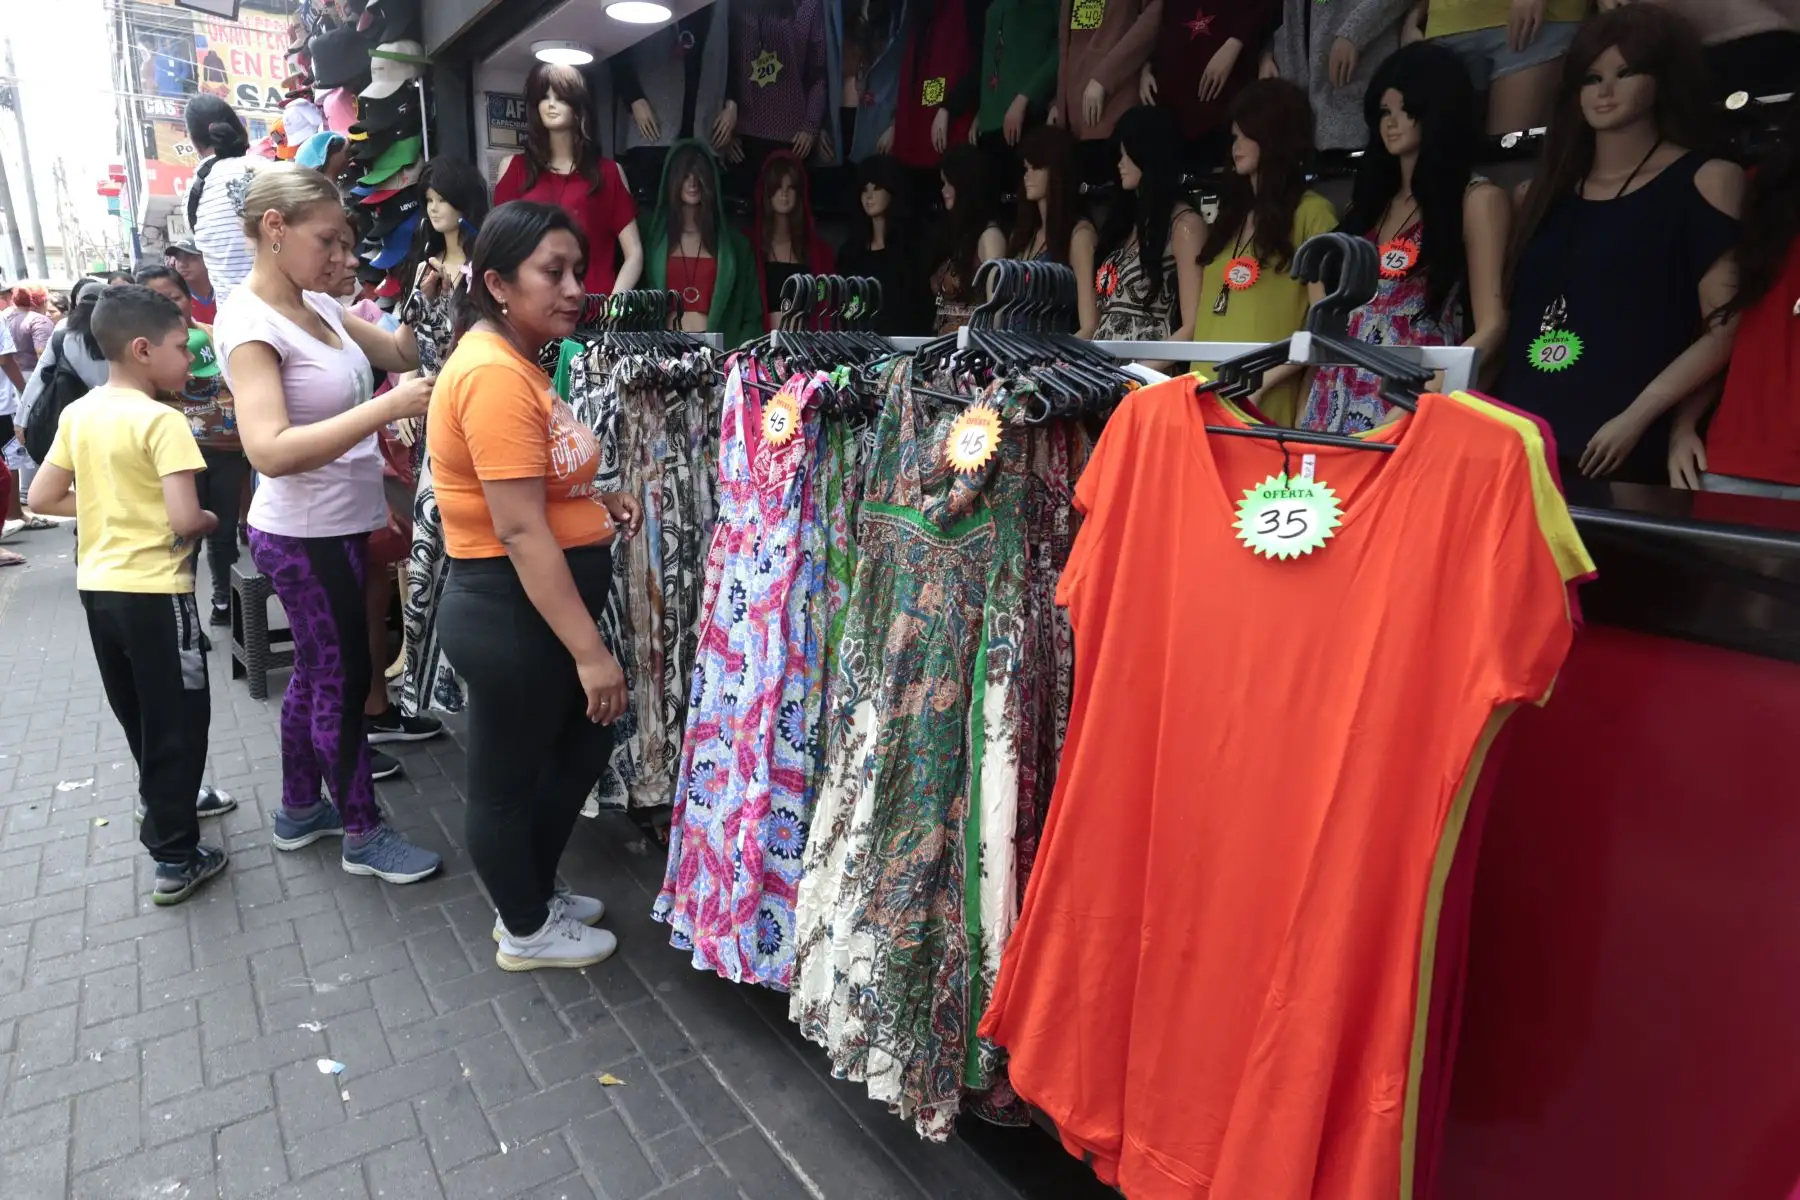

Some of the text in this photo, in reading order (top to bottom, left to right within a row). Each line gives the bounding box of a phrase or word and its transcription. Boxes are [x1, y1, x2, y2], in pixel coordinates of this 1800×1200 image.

[1085, 10, 1099, 22] 40
[230, 49, 263, 78] EN
[758, 63, 776, 79] 20
[1386, 252, 1406, 269] 45
[1230, 268, 1250, 284] 35
[200, 345, 214, 363] NY
[1540, 344, 1567, 363] 20
[770, 411, 787, 432] 45
[961, 431, 986, 455] 45
[1263, 489, 1315, 499] OFERTA
[1256, 508, 1308, 539] 35
